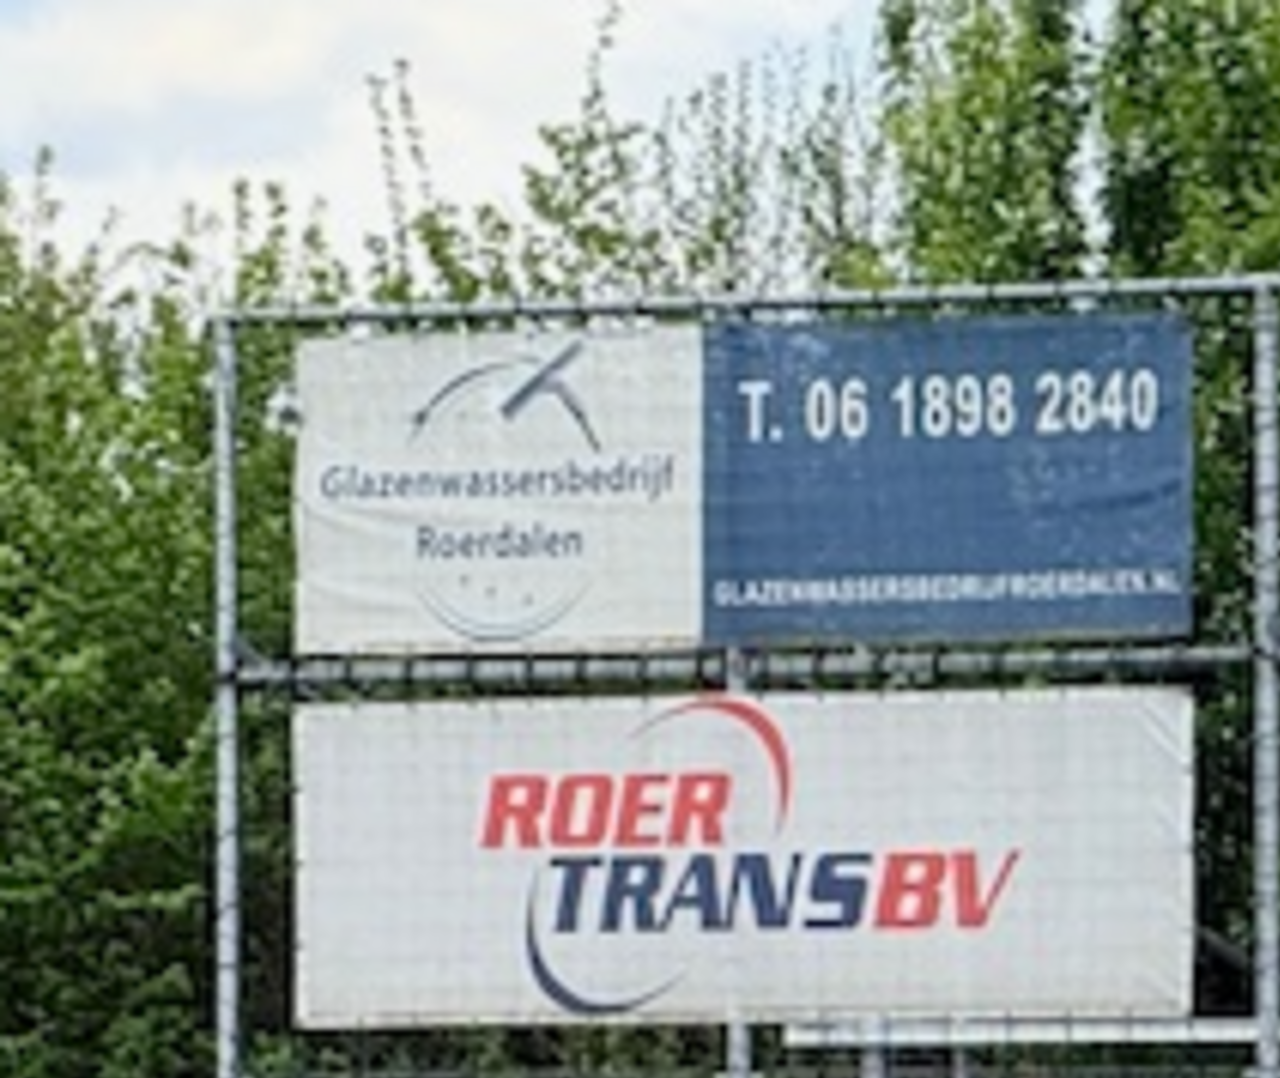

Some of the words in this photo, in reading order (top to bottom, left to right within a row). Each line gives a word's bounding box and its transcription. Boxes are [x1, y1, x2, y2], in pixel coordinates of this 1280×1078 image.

[738, 381, 782, 443] T.
[805, 380, 869, 438] 06
[891, 374, 1016, 436] 1898
[1035, 368, 1159, 433] 2840
[320, 456, 674, 503] Glazenwassersbedrijf
[416, 524, 584, 560] Roerdalen
[479, 771, 732, 849] ROER
